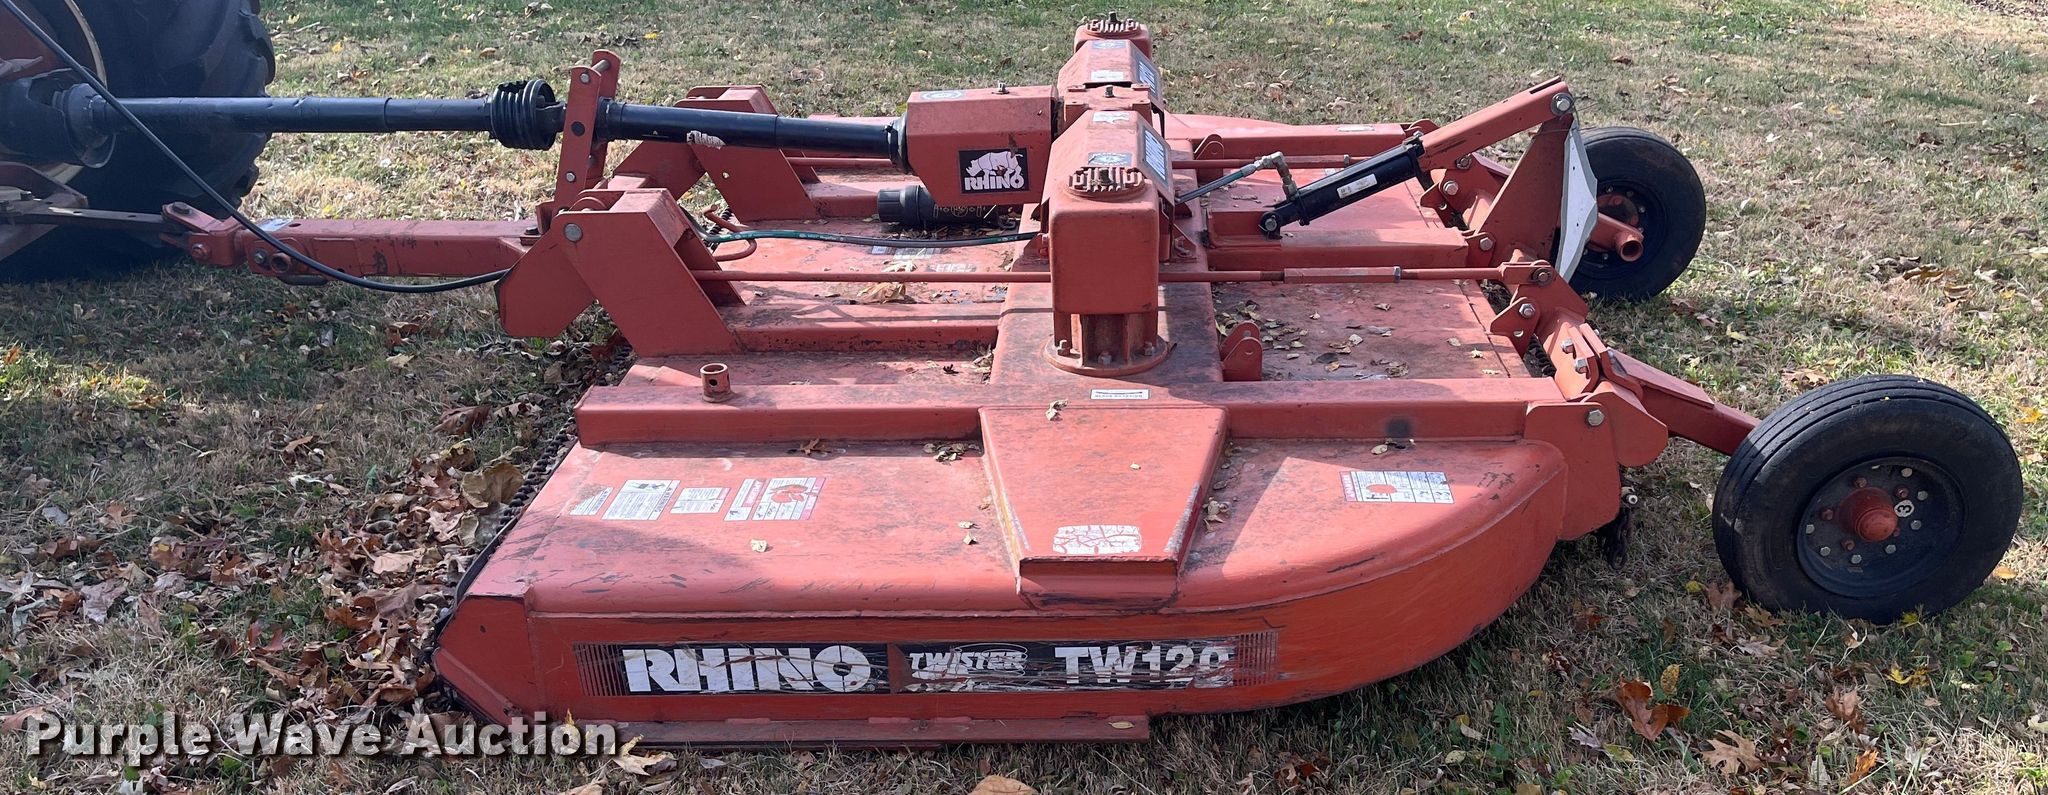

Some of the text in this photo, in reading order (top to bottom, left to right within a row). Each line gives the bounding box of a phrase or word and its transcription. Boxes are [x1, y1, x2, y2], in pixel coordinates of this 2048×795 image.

[964, 173, 1025, 191] RHINO
[622, 645, 871, 692] RHINO
[909, 650, 1028, 673] TWISTER
